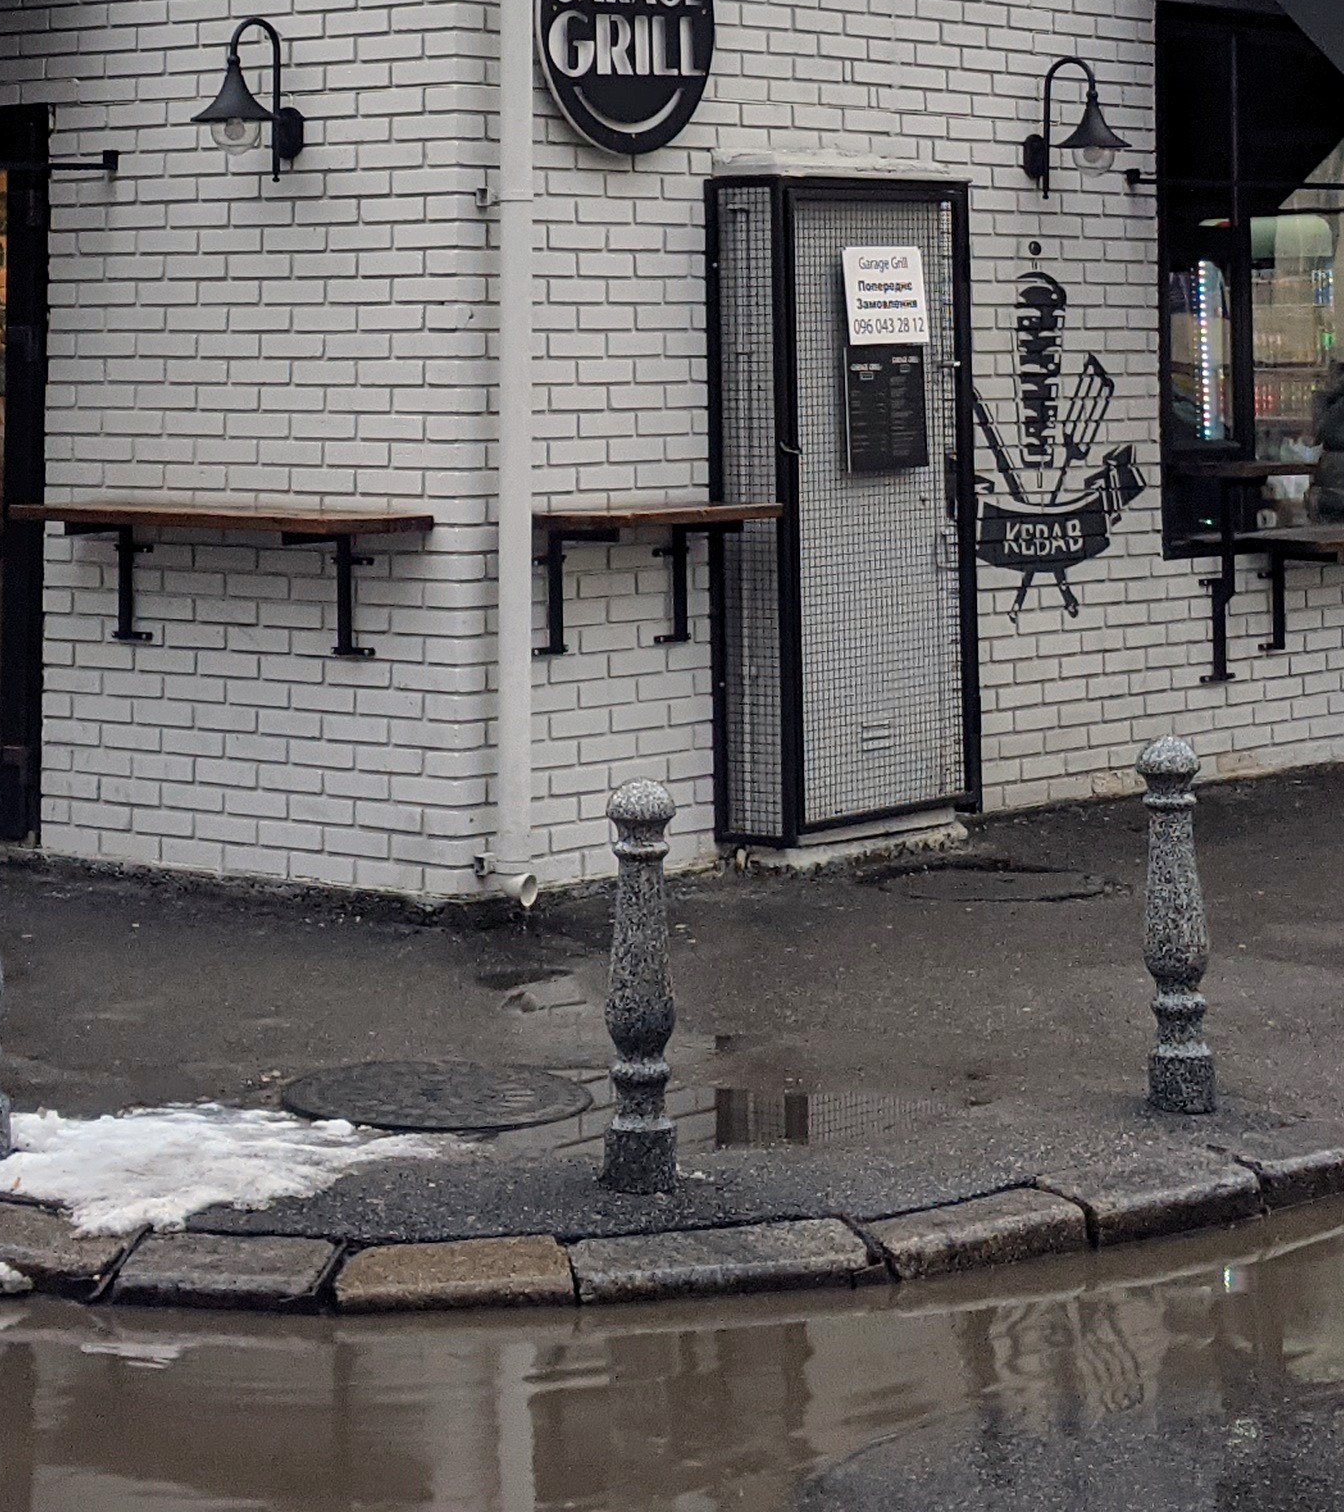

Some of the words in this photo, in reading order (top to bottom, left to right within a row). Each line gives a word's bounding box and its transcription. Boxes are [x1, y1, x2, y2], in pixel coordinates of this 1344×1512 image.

[547, 9, 706, 78] GRILL
[858, 256, 889, 273] Garage
[890, 256, 909, 269] Grill
[856, 298, 918, 310] Замовлення
[853, 318, 874, 335] 096
[875, 318, 895, 334] 043
[897, 317, 910, 333] 28
[912, 316, 925, 333] 12
[1003, 518, 1084, 556] KEBAB
